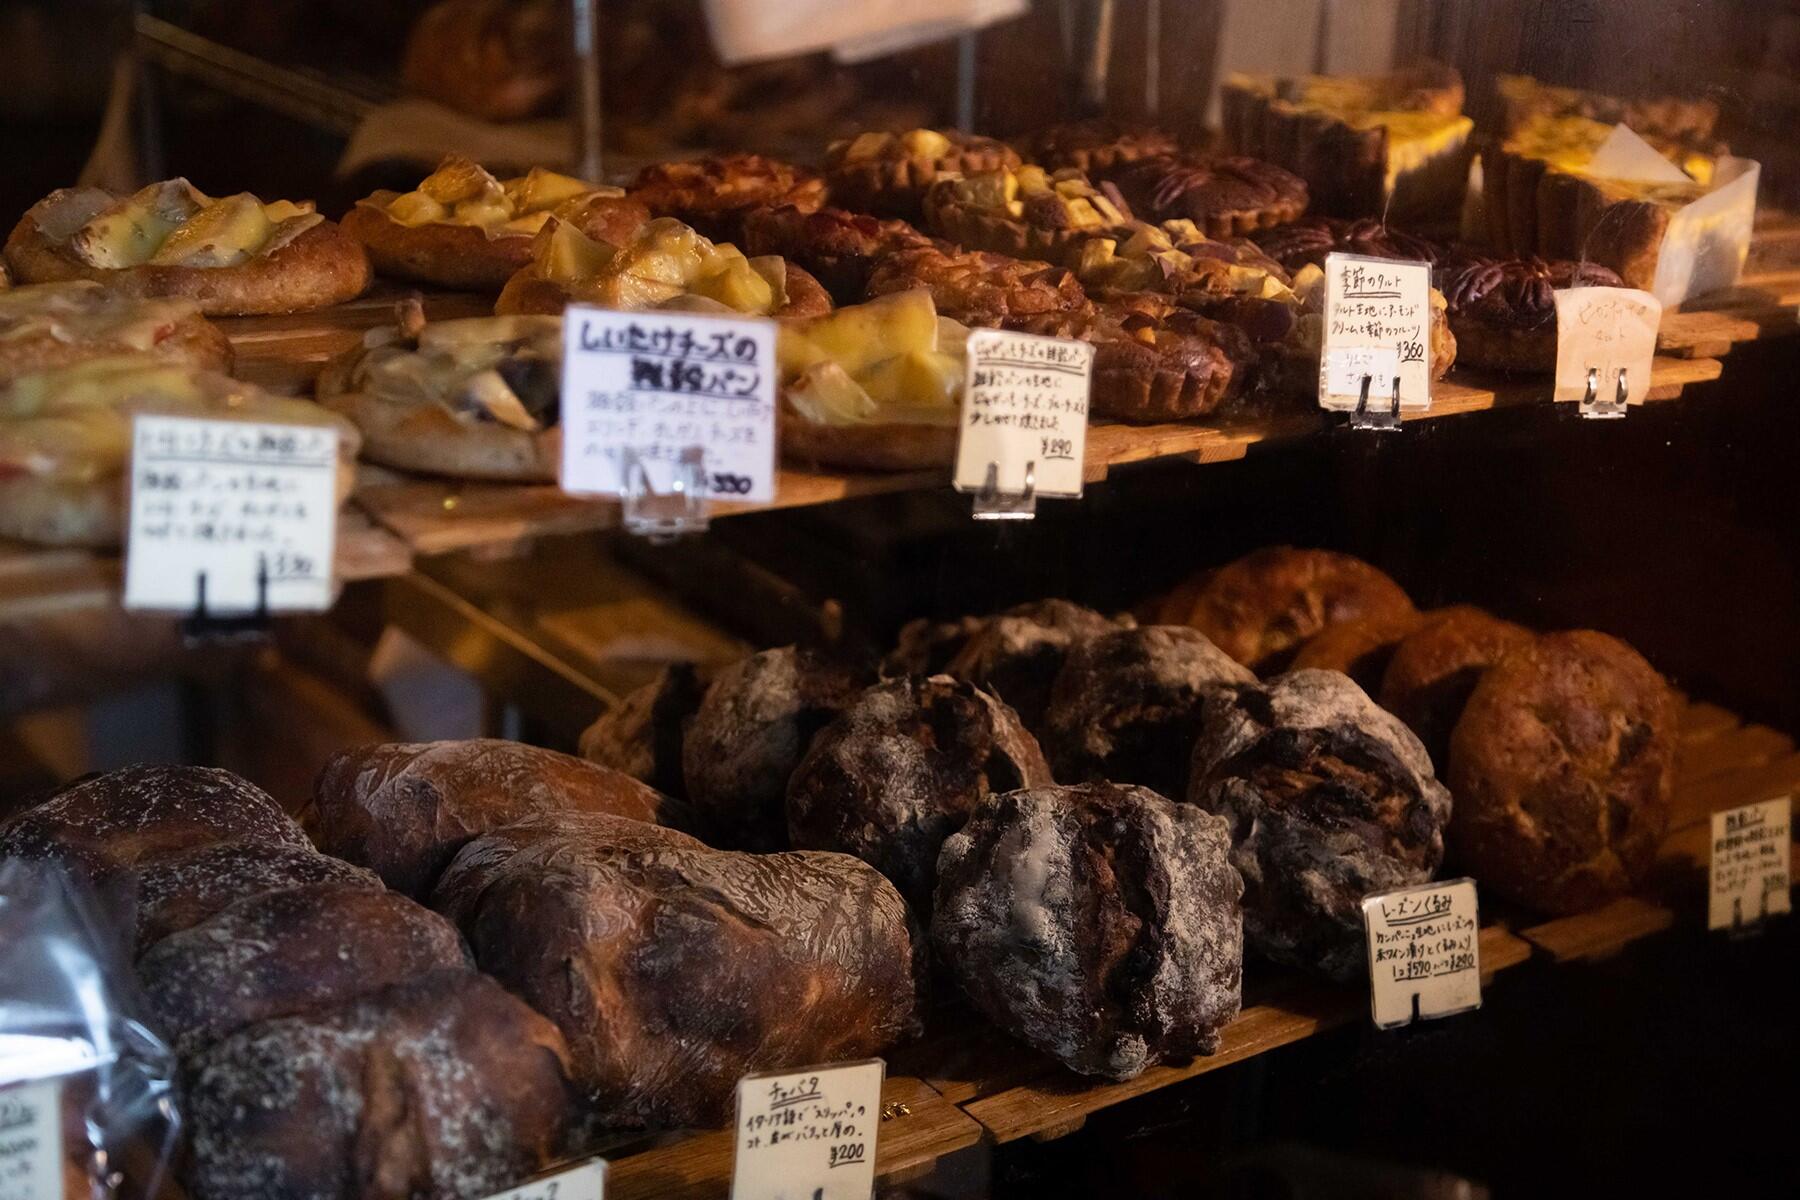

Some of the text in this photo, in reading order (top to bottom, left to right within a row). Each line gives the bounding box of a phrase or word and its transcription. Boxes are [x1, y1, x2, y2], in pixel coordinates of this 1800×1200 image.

[1341, 265, 1401, 292] 季節のタルト
[582, 318, 758, 362] しいたけチーズの
[1381, 894, 1452, 918] レーズンくるみ
[769, 1077, 820, 1101] チャバタ
[829, 1142, 865, 1166] ¥200
